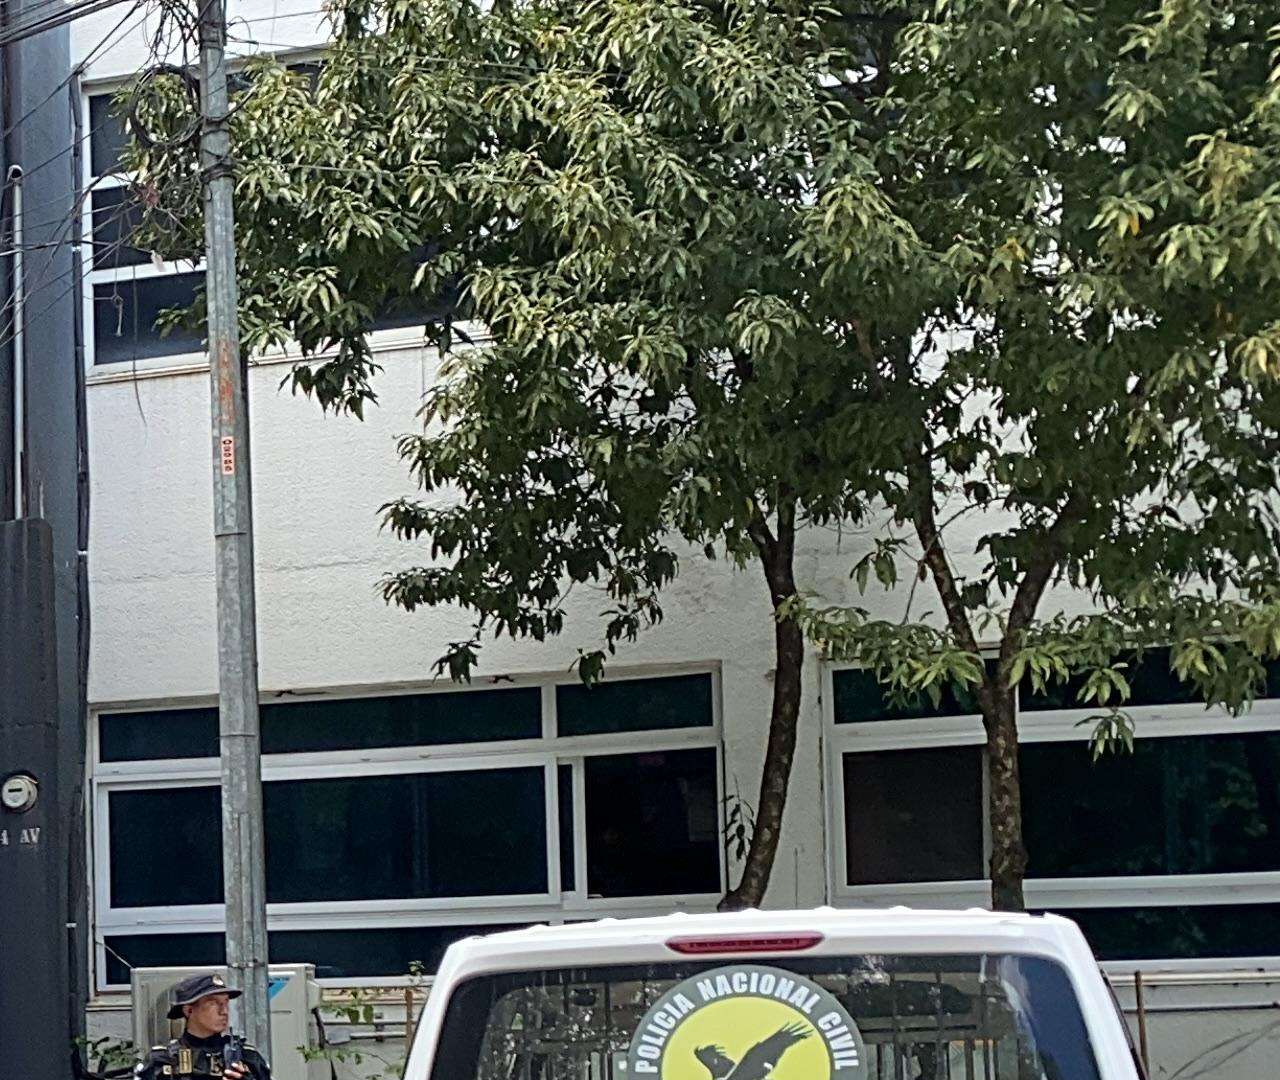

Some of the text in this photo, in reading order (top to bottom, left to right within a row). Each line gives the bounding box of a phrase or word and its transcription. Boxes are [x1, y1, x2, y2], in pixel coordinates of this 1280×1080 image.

[19, 827, 41, 844] AV
[635, 972, 859, 1074] POLICIA NACIONAL CIVIL
